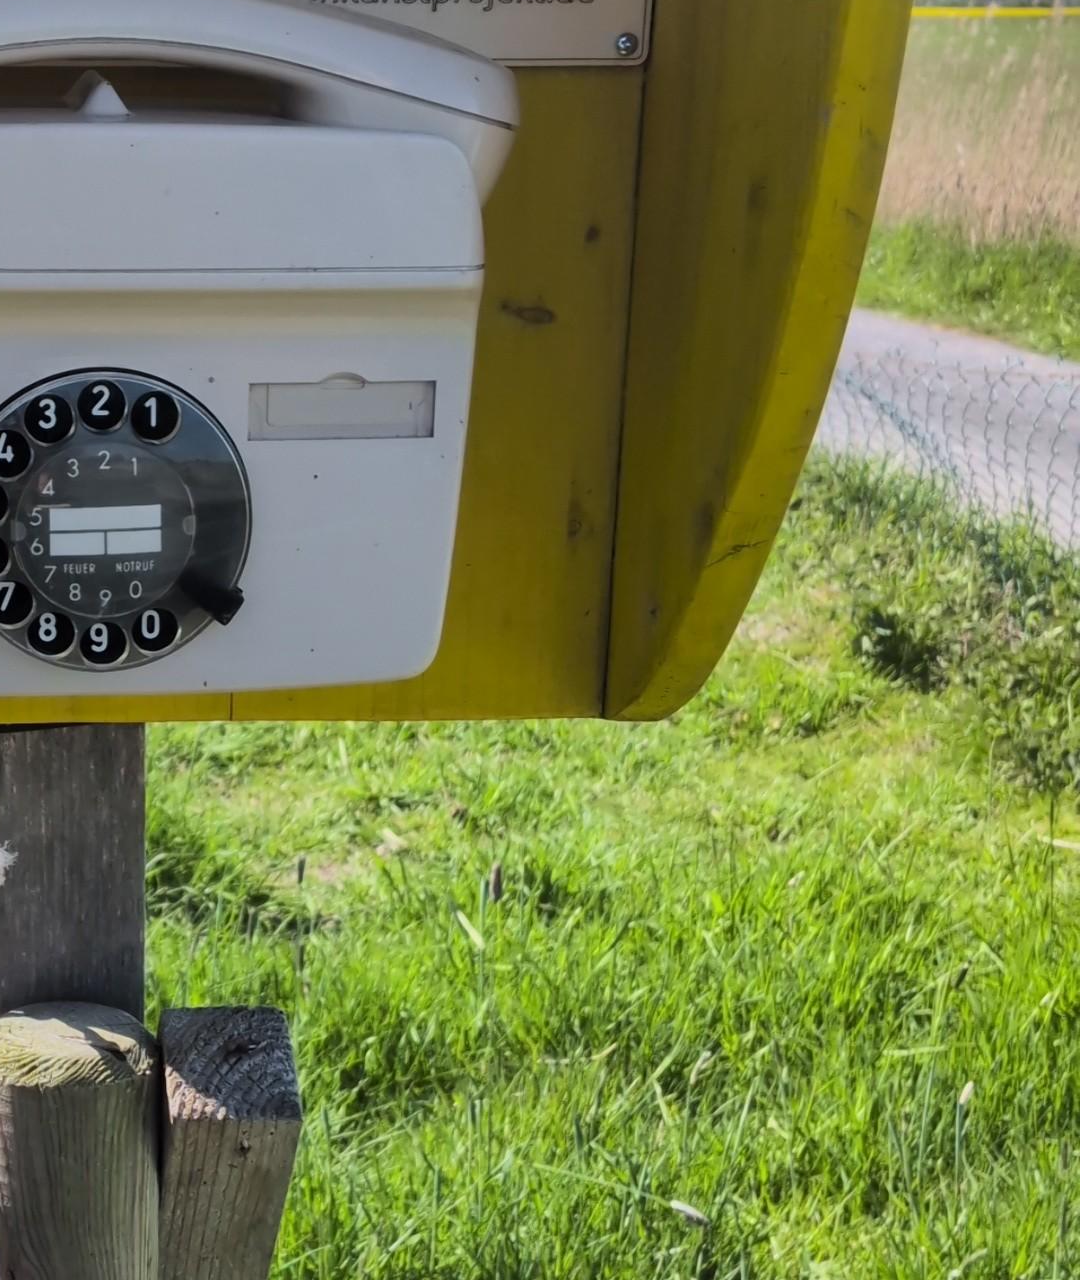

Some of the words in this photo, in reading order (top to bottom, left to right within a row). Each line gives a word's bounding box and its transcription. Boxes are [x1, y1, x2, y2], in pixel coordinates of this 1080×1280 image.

[90, 384, 110, 417] 2
[37, 398, 57, 430] 3
[143, 396, 158, 428] 1
[66, 458, 80, 478] 3
[97, 450, 112, 470] 2
[130, 457, 138, 477] 1
[40, 478, 56, 497] 4
[28, 507, 42, 527] 5
[29, 538, 45, 556] 6
[43, 564, 57, 584] 7
[115, 560, 155, 573] NOTRUF
[68, 583, 82, 602] 8
[98, 589, 112, 608] 9
[128, 580, 143, 599] 0
[38, 612, 57, 642] 8
[140, 608, 161, 640] 0
[89, 622, 109, 653] 9
